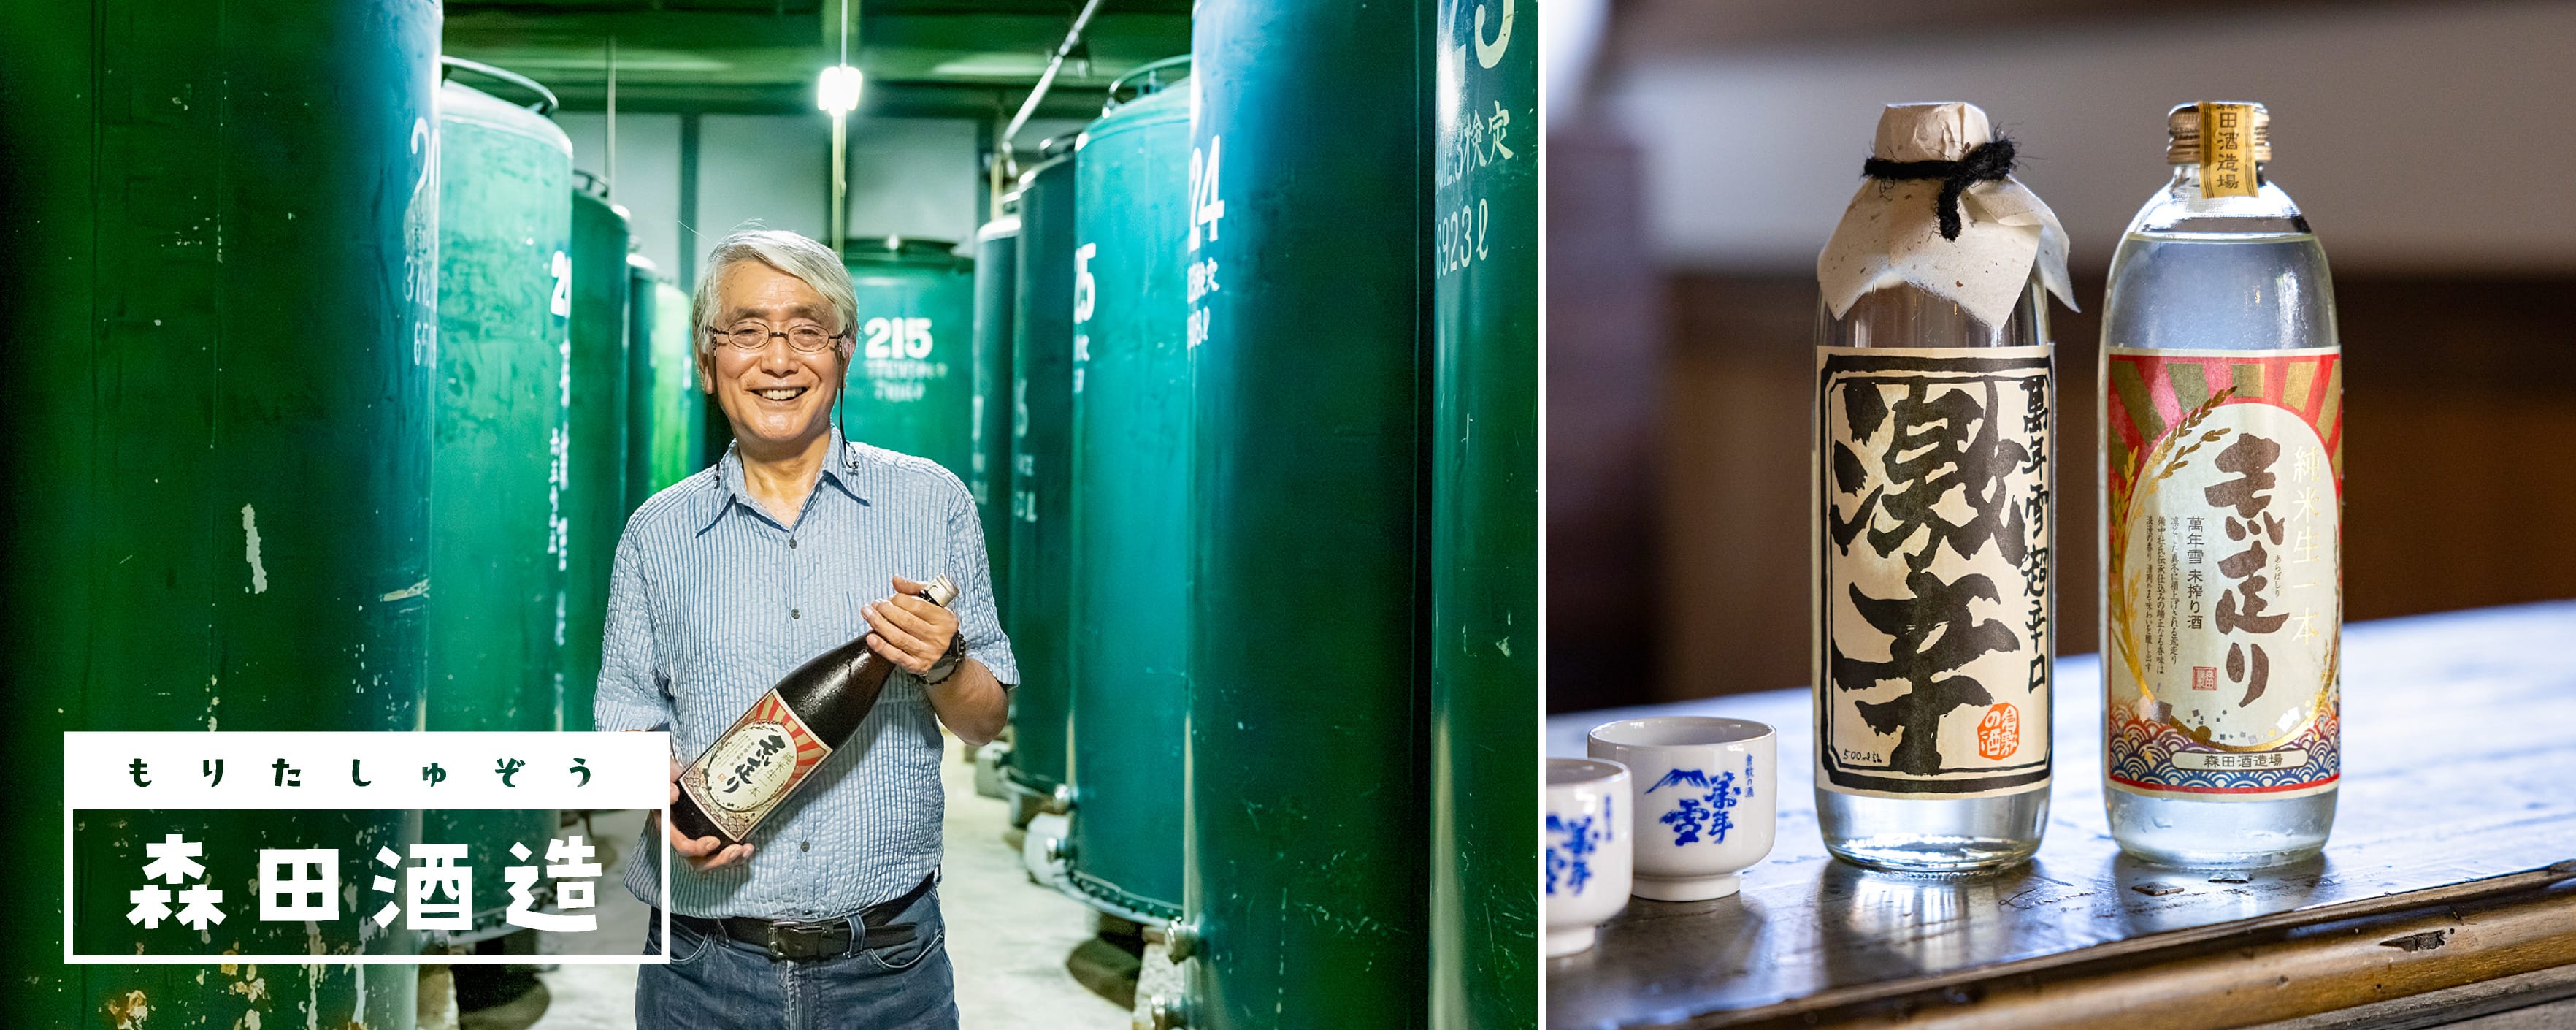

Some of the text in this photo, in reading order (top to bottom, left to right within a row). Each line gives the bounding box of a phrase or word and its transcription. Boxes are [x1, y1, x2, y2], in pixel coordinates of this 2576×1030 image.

[1188, 134, 1225, 253] 24
[864, 316, 933, 359] 215
[1829, 375, 2026, 776] 激辛
[2274, 554, 2282, 598] あらばしり
[2292, 446, 2320, 646] 純米生一本
[2204, 753, 2283, 768] 森田酒造場
